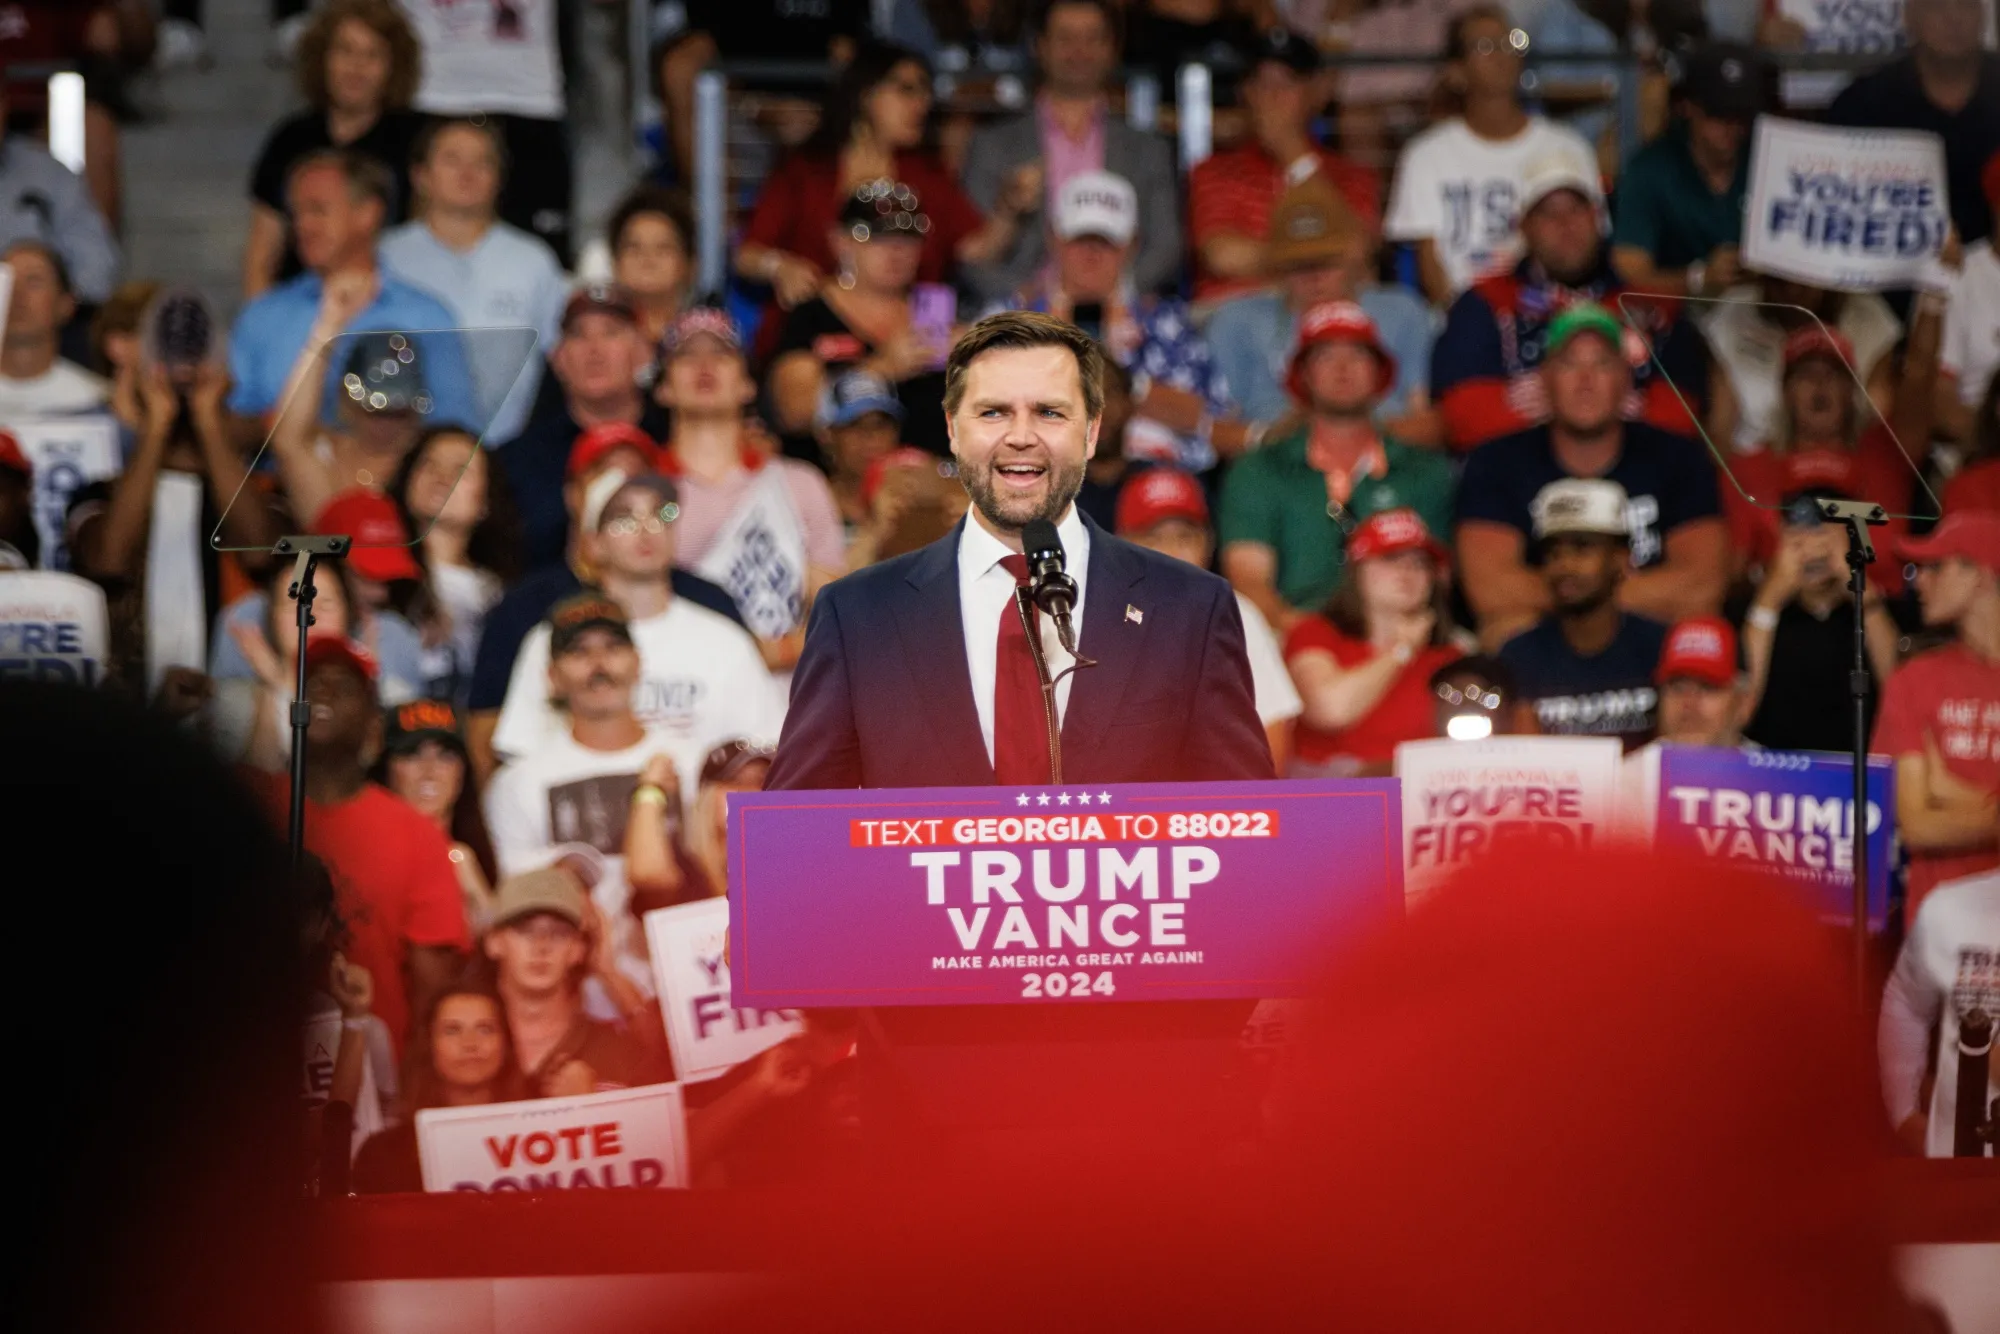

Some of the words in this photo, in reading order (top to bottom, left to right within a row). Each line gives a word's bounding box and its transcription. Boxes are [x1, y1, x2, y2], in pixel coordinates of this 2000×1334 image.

[1769, 197, 1944, 258] FIRED!
[1424, 786, 1583, 818] YOU'RE
[1669, 786, 1882, 836] TRUMP
[860, 820, 943, 845] TEXT
[953, 816, 1105, 843] GEORGIA
[1114, 815, 1159, 839] TO
[1168, 812, 1270, 838] 88022
[1697, 825, 1855, 872] VANCE
[911, 845, 1220, 905] TRUMP
[947, 903, 1187, 950] VANCE
[932, 955, 982, 969] MAKE
[988, 953, 1070, 968] AMERICA
[1075, 952, 1134, 966] GREAT
[1141, 951, 1204, 965] AGAIN!
[1021, 971, 1116, 998] 2024
[484, 1121, 623, 1169] VOTE
